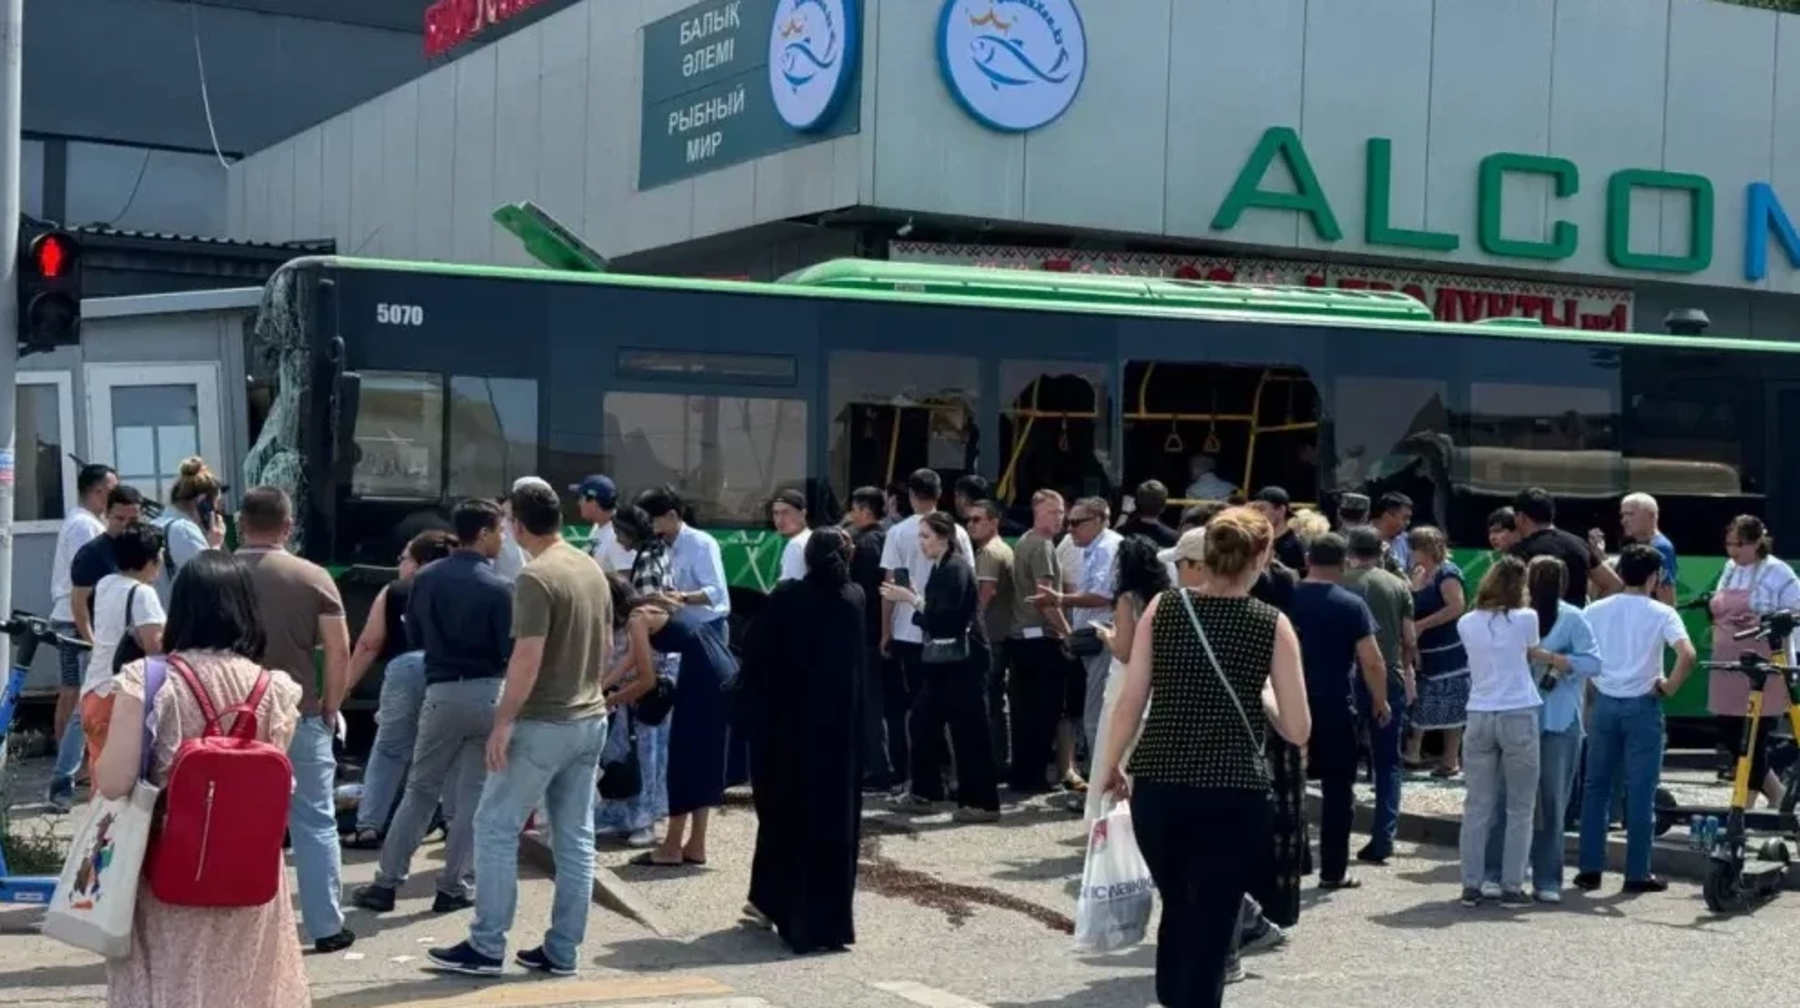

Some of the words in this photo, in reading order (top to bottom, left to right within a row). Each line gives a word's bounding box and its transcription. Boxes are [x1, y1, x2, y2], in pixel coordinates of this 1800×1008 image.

[682, 38, 735, 77] ӘЛЕМІ
[668, 84, 746, 136] РЫБНЫЙ
[686, 131, 722, 163] МИР
[376, 303, 424, 326] 5070
[1338, 278, 1577, 328] ДУКТЫ
